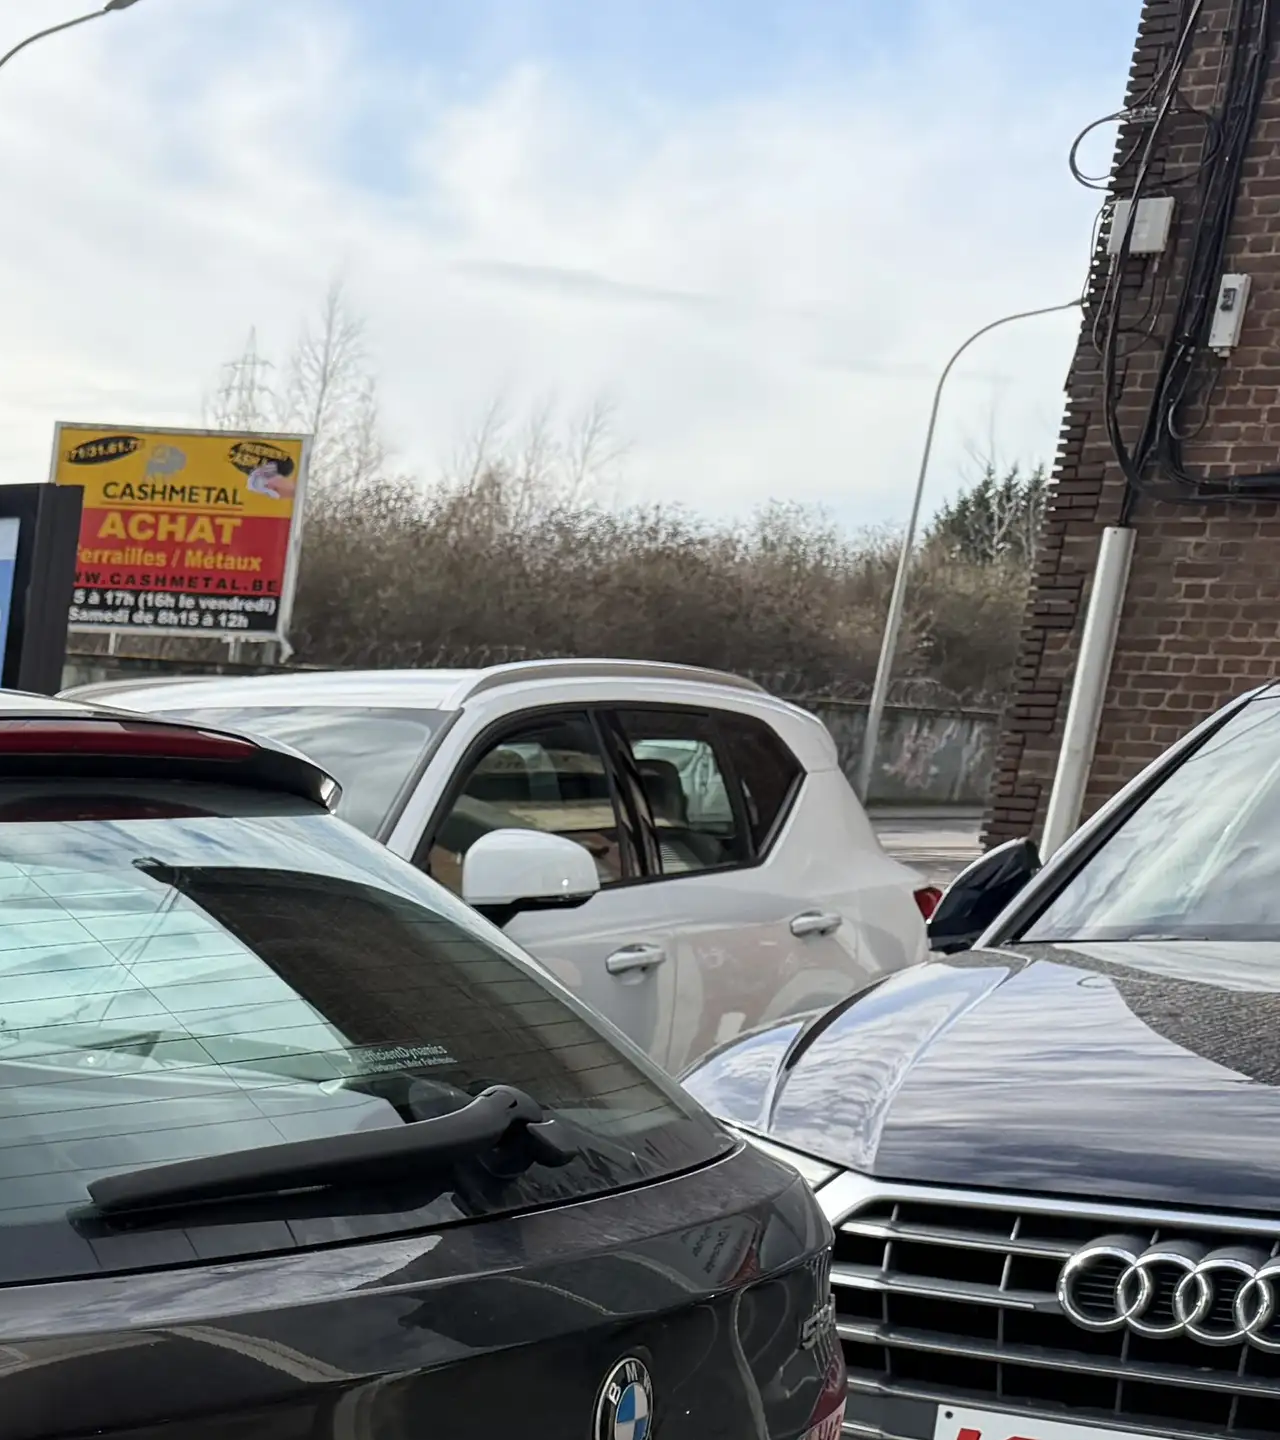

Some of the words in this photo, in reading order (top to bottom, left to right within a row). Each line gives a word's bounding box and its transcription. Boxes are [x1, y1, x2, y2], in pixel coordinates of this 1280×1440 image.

[102, 481, 244, 506] CASHMETAL
[97, 510, 243, 546] ACHAT
[78, 546, 168, 568] errailles
[184, 548, 264, 572] Métaux
[104, 590, 136, 607] 17h
[178, 592, 196, 609] le
[199, 595, 278, 616] vendredi)
[67, 605, 131, 624] Samedi
[131, 608, 155, 624] de
[217, 612, 249, 629] 12h
[608, 1361, 652, 1405] BMW
